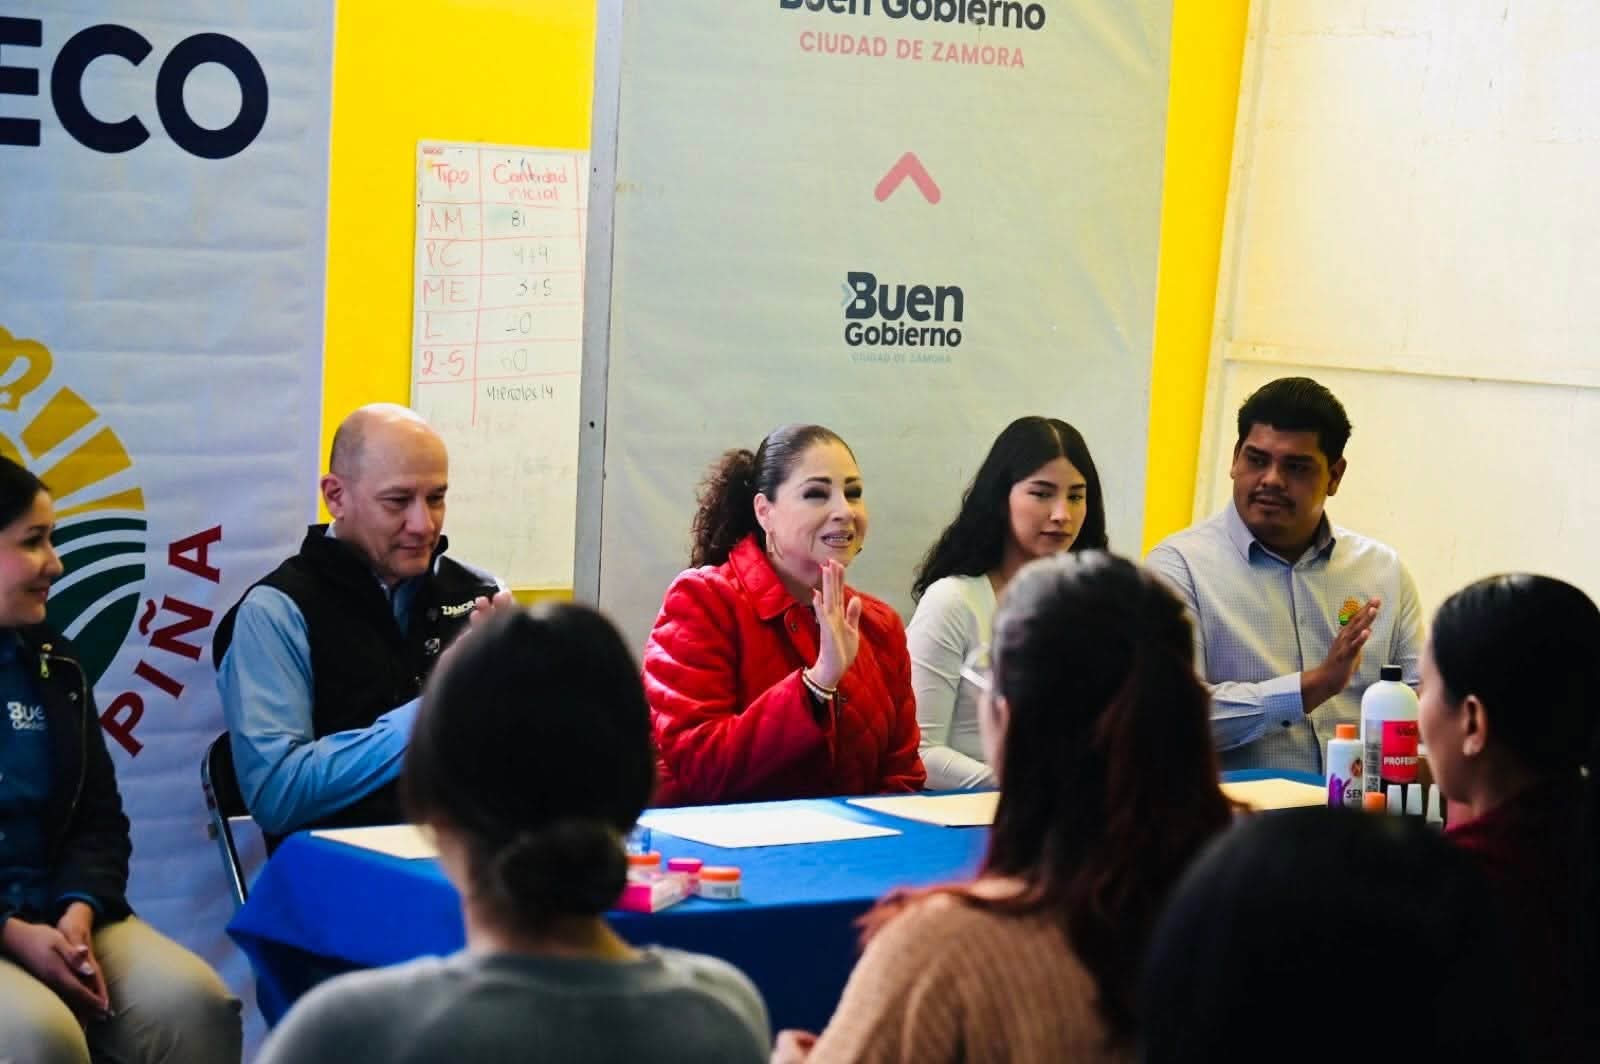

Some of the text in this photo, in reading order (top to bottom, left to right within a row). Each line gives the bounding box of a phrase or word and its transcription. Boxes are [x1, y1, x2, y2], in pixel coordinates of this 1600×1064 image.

[882, 0, 1047, 31] Gobierno
[800, 31, 1024, 68] CIUDAD DE ZAMORA
[0, 16, 269, 160] ECO
[431, 164, 470, 192] Tipo
[428, 208, 464, 233] AM
[426, 241, 463, 269] PC
[423, 279, 468, 304] ME
[845, 271, 964, 323] Buen
[424, 312, 442, 339] L
[845, 322, 962, 347] Gobierno
[441, 600, 477, 617] ZAMOR
[98, 524, 222, 758] PIÑA
[7, 701, 46, 721] Bue
